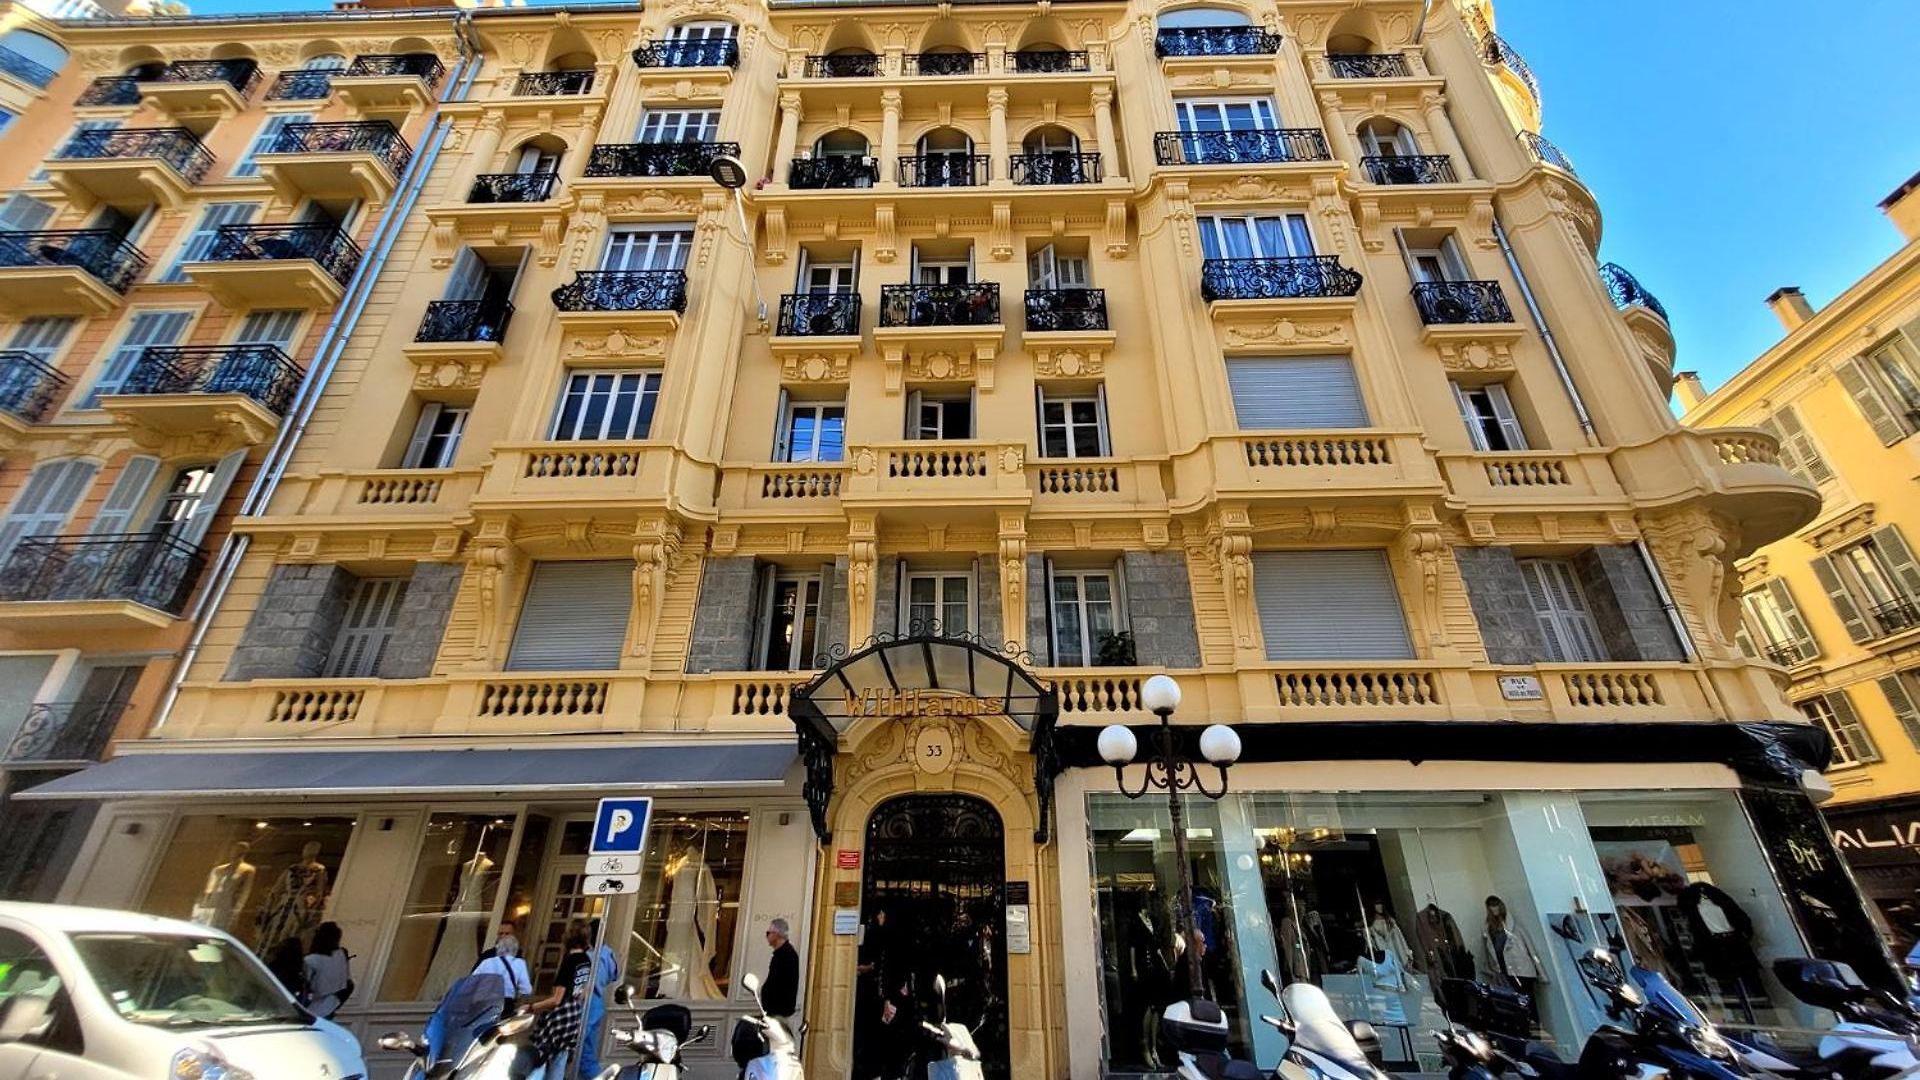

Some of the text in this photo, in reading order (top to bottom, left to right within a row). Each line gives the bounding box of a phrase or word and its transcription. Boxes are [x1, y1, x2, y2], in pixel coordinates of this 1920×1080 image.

[843, 687, 1003, 717] Williams
[925, 744, 943, 757] 33
[606, 808, 634, 843] P
